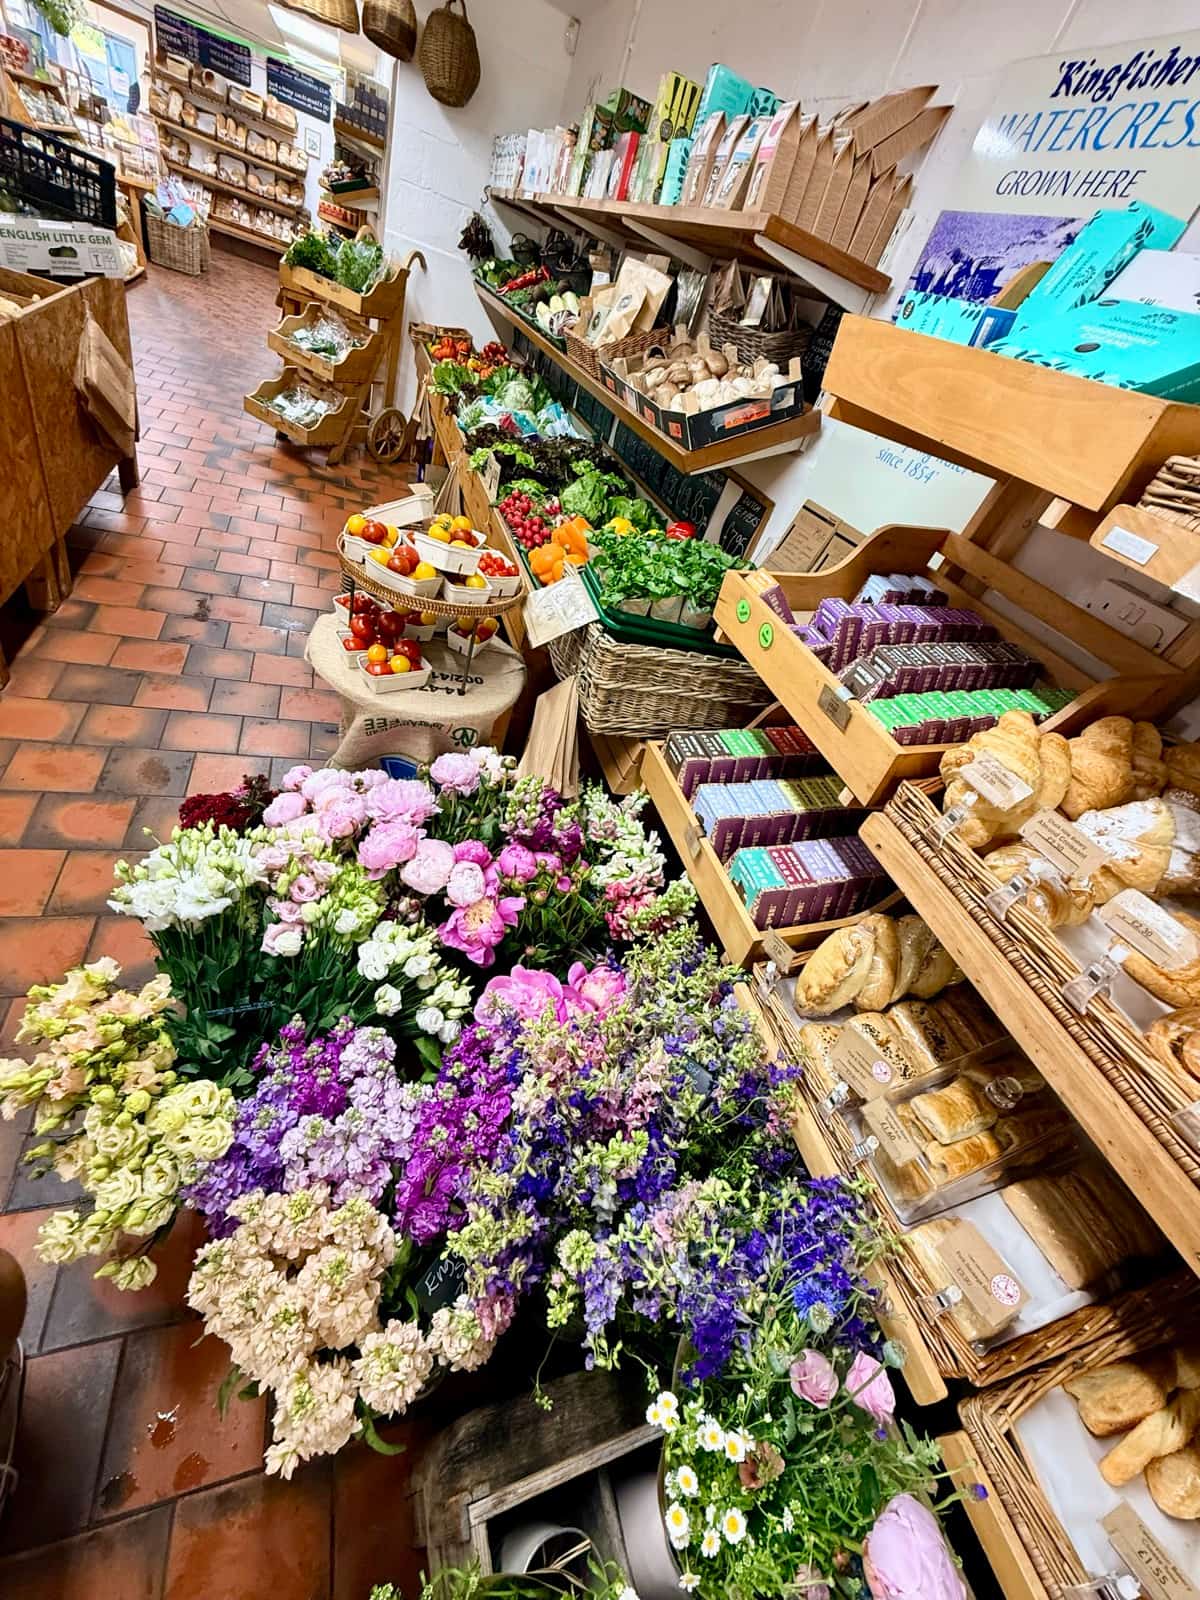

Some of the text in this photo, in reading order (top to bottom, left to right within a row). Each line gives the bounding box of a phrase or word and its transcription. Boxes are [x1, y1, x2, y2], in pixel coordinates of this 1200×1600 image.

[998, 99, 1200, 152] WATERCRES
[996, 170, 1147, 197] GROWN HERE
[0, 228, 112, 246] ENGLISH LITTLE GEM
[876, 448, 903, 469] since
[1138, 1550, 1169, 1585] £1.55
